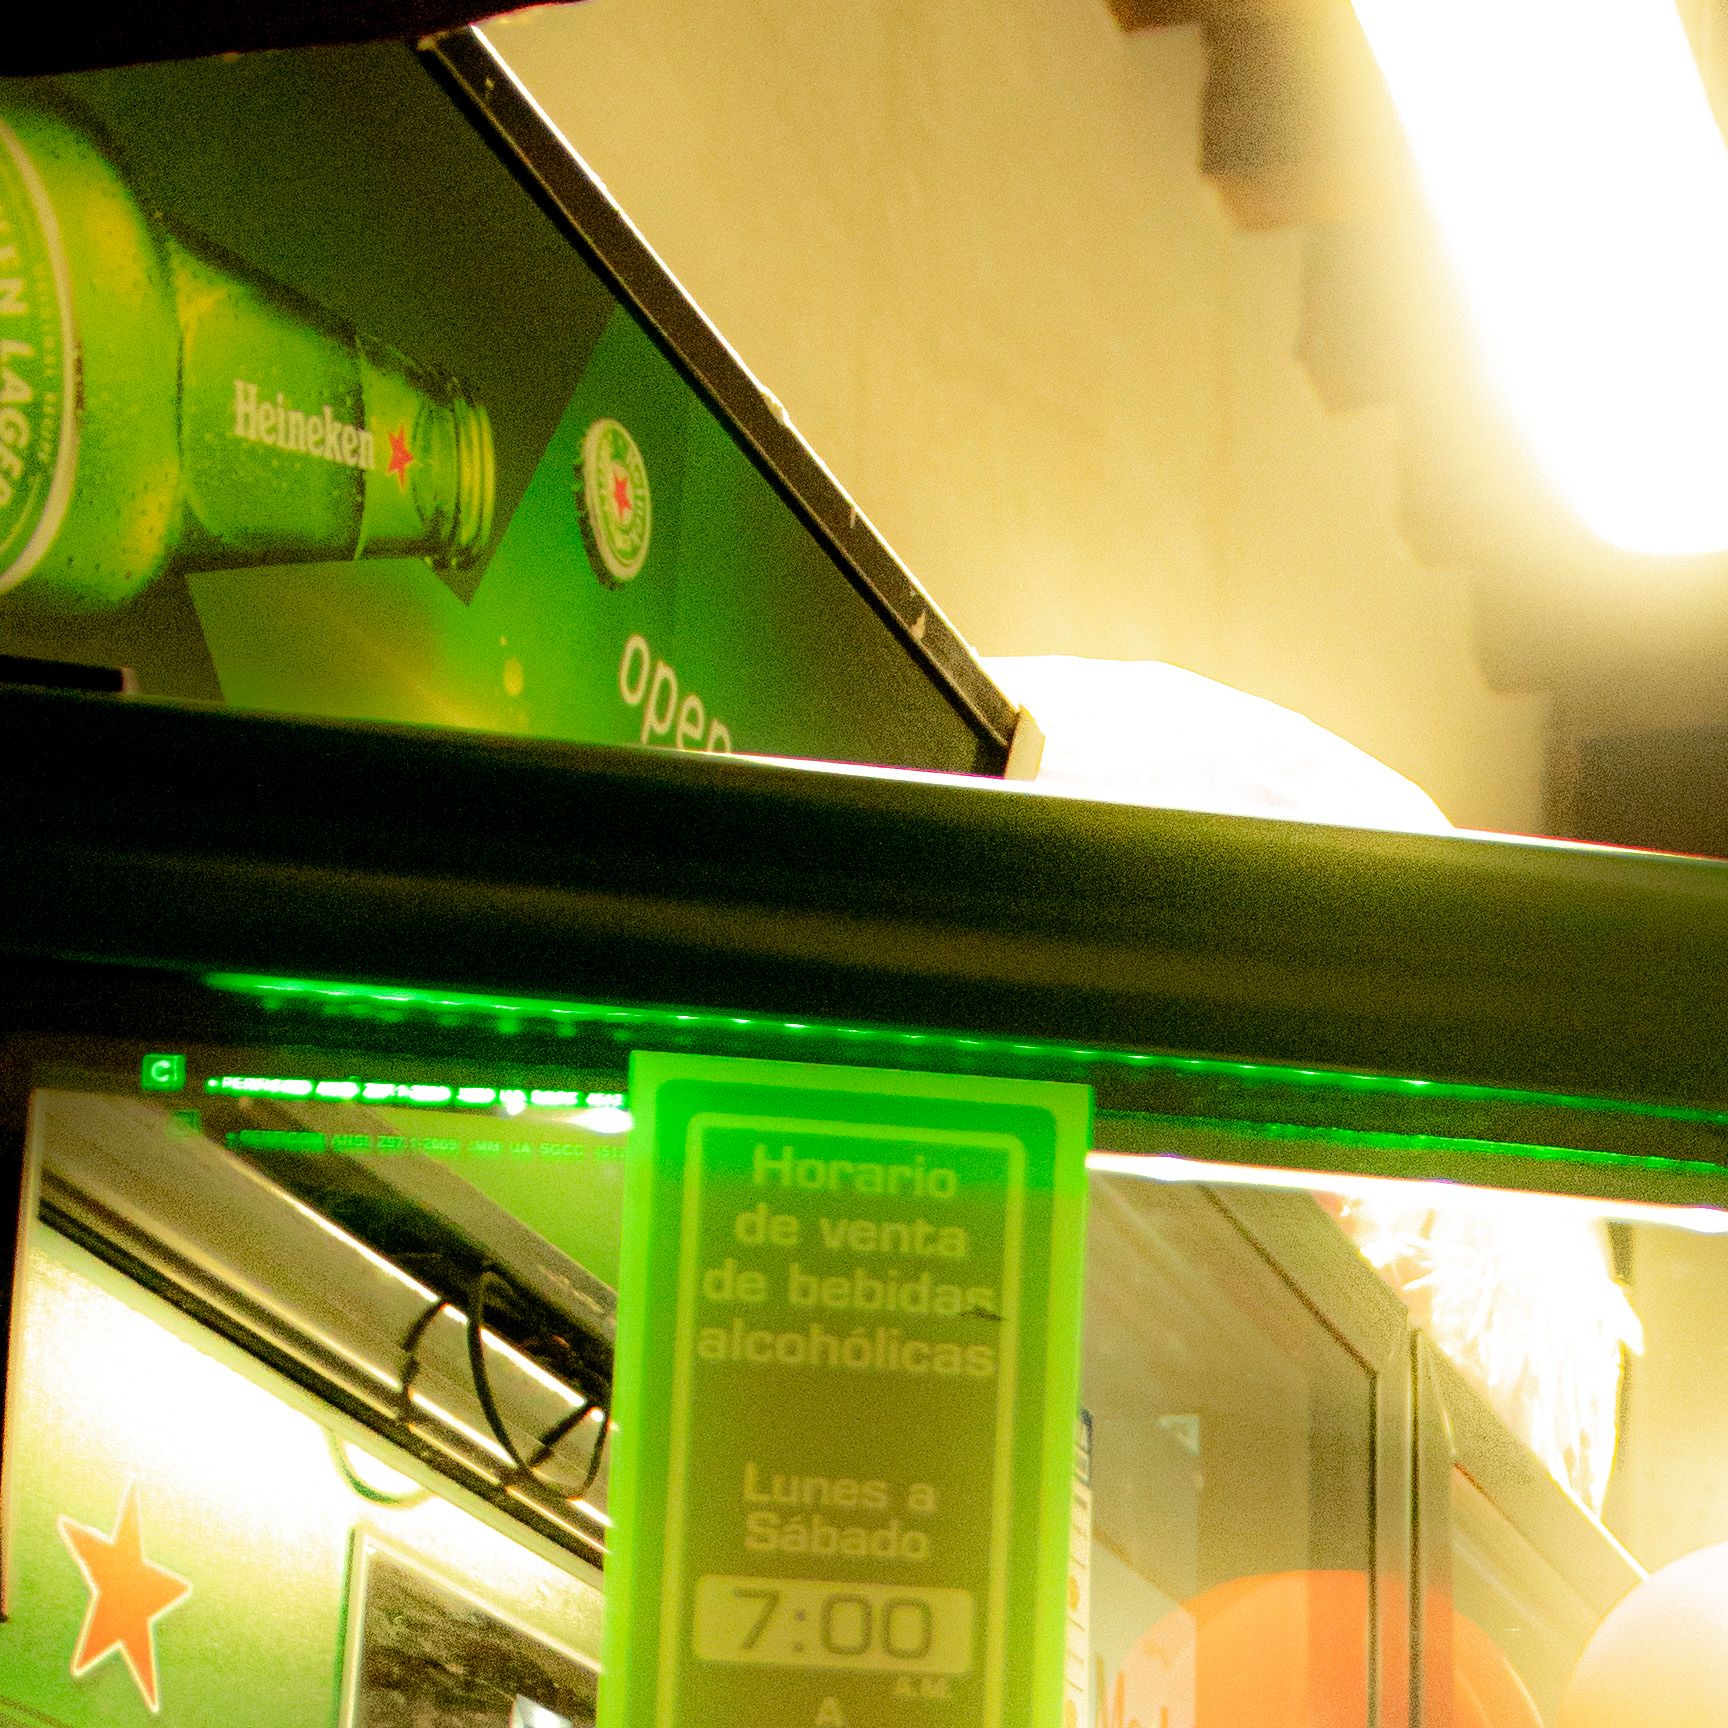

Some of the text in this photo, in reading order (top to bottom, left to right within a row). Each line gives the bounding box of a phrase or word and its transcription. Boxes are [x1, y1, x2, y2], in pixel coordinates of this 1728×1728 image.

[233, 378, 375, 470] Heineken
[752, 1142, 958, 1200] Horario
[735, 1202, 970, 1259] de venta
[702, 1258, 996, 1316] de bebidas
[697, 1317, 999, 1378] alcohólicas
[744, 1462, 938, 1514] Lunes a
[743, 1512, 929, 1563] Sábado
[733, 1586, 934, 1660] 7:00
[815, 1696, 845, 1728] A
